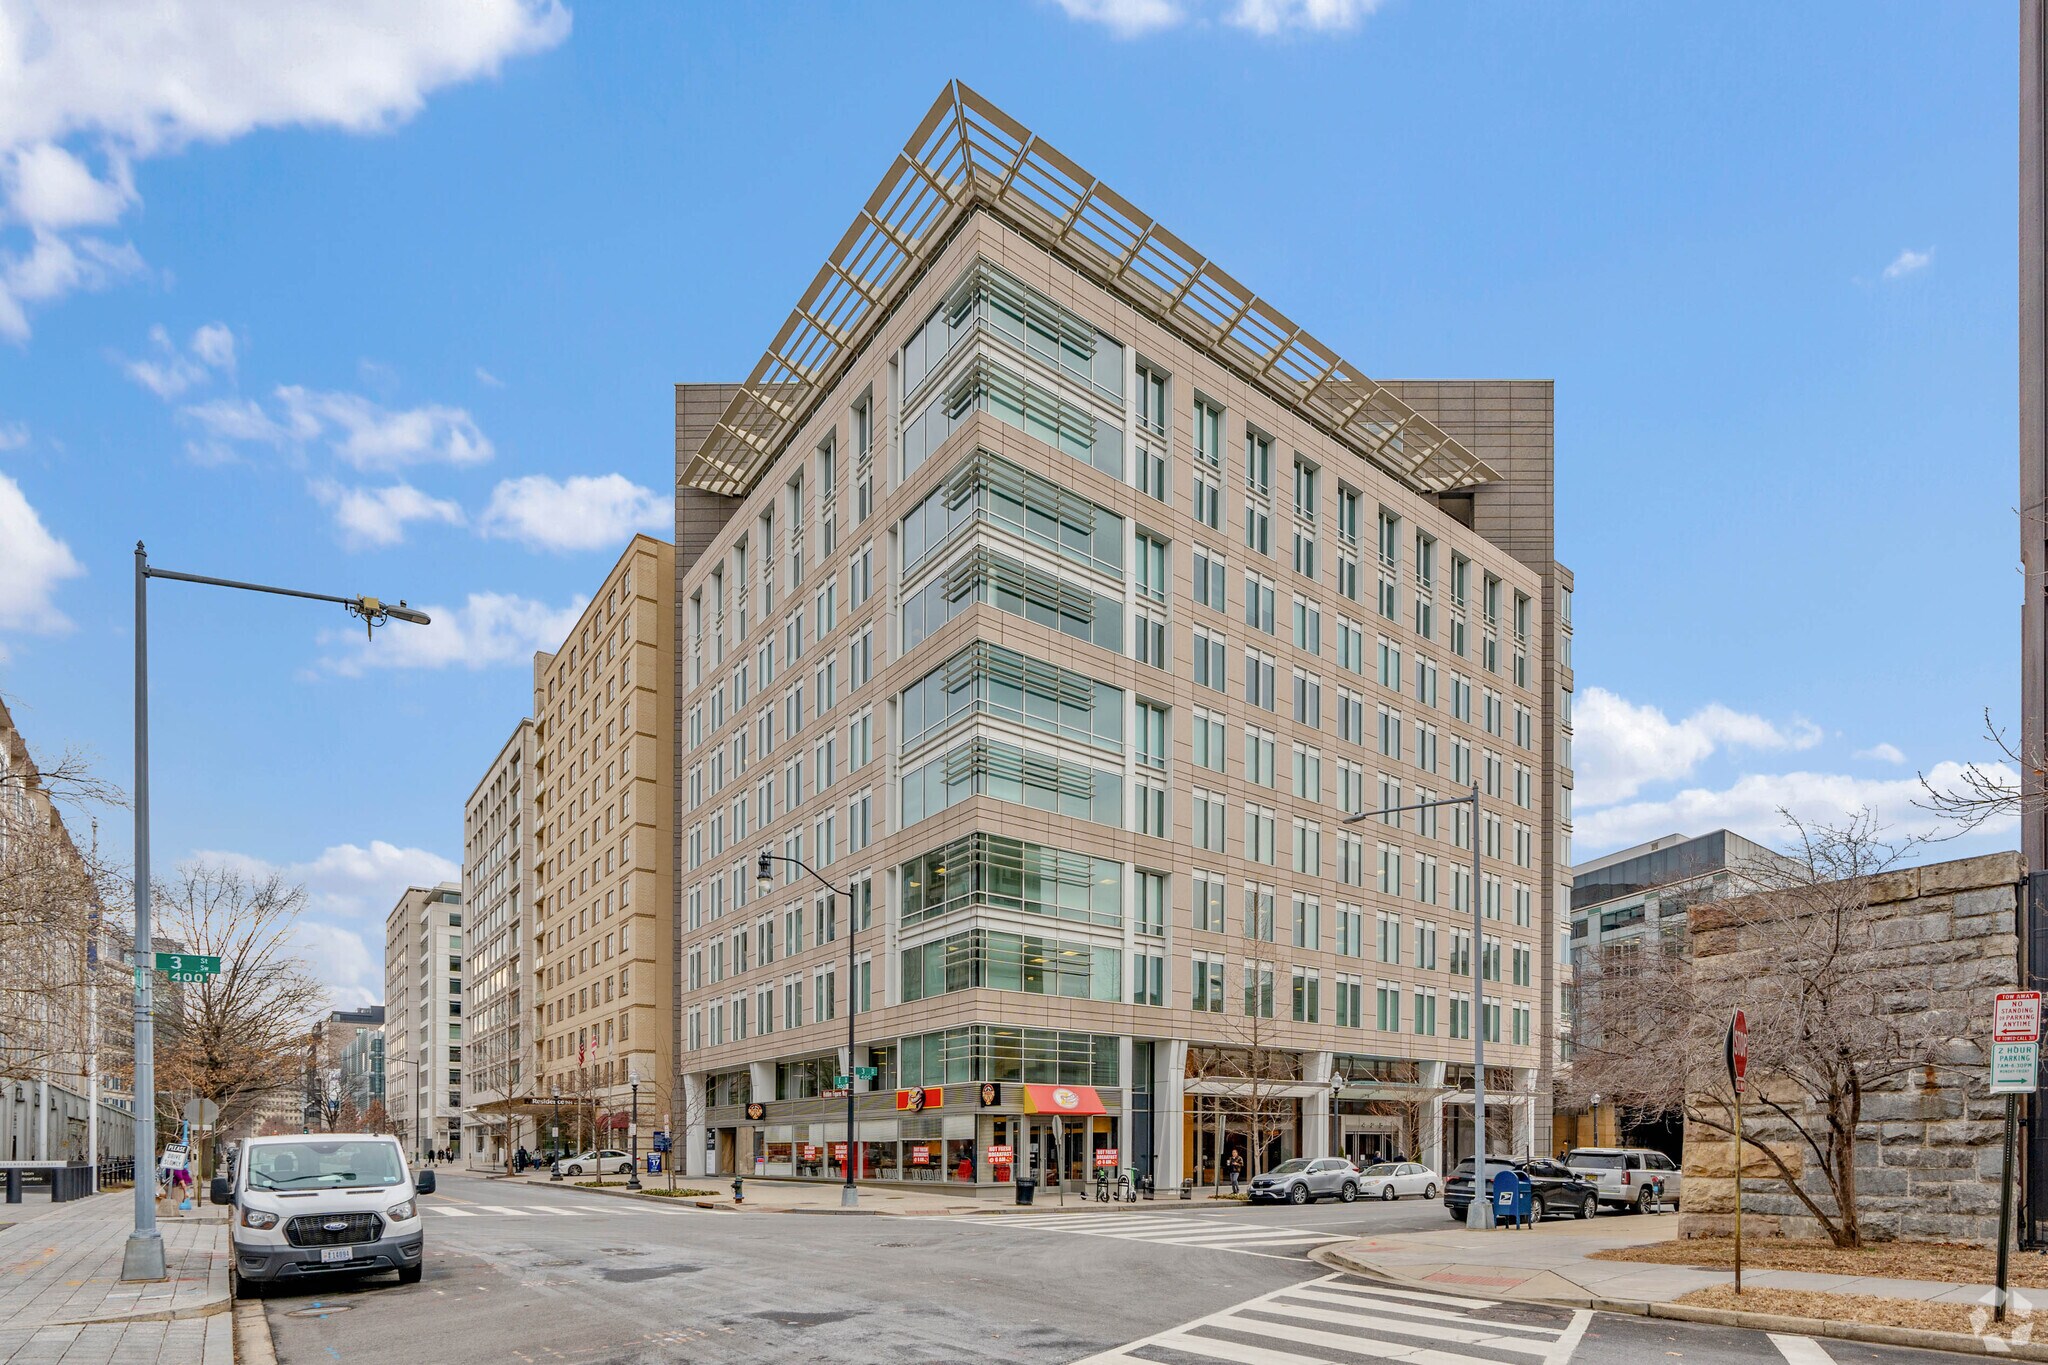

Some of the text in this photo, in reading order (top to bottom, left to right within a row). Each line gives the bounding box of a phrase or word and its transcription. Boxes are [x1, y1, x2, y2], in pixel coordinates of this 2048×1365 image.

[170, 956, 182, 969] 3
[171, 972, 204, 982] 400
[1734, 1030, 1747, 1057] STOP
